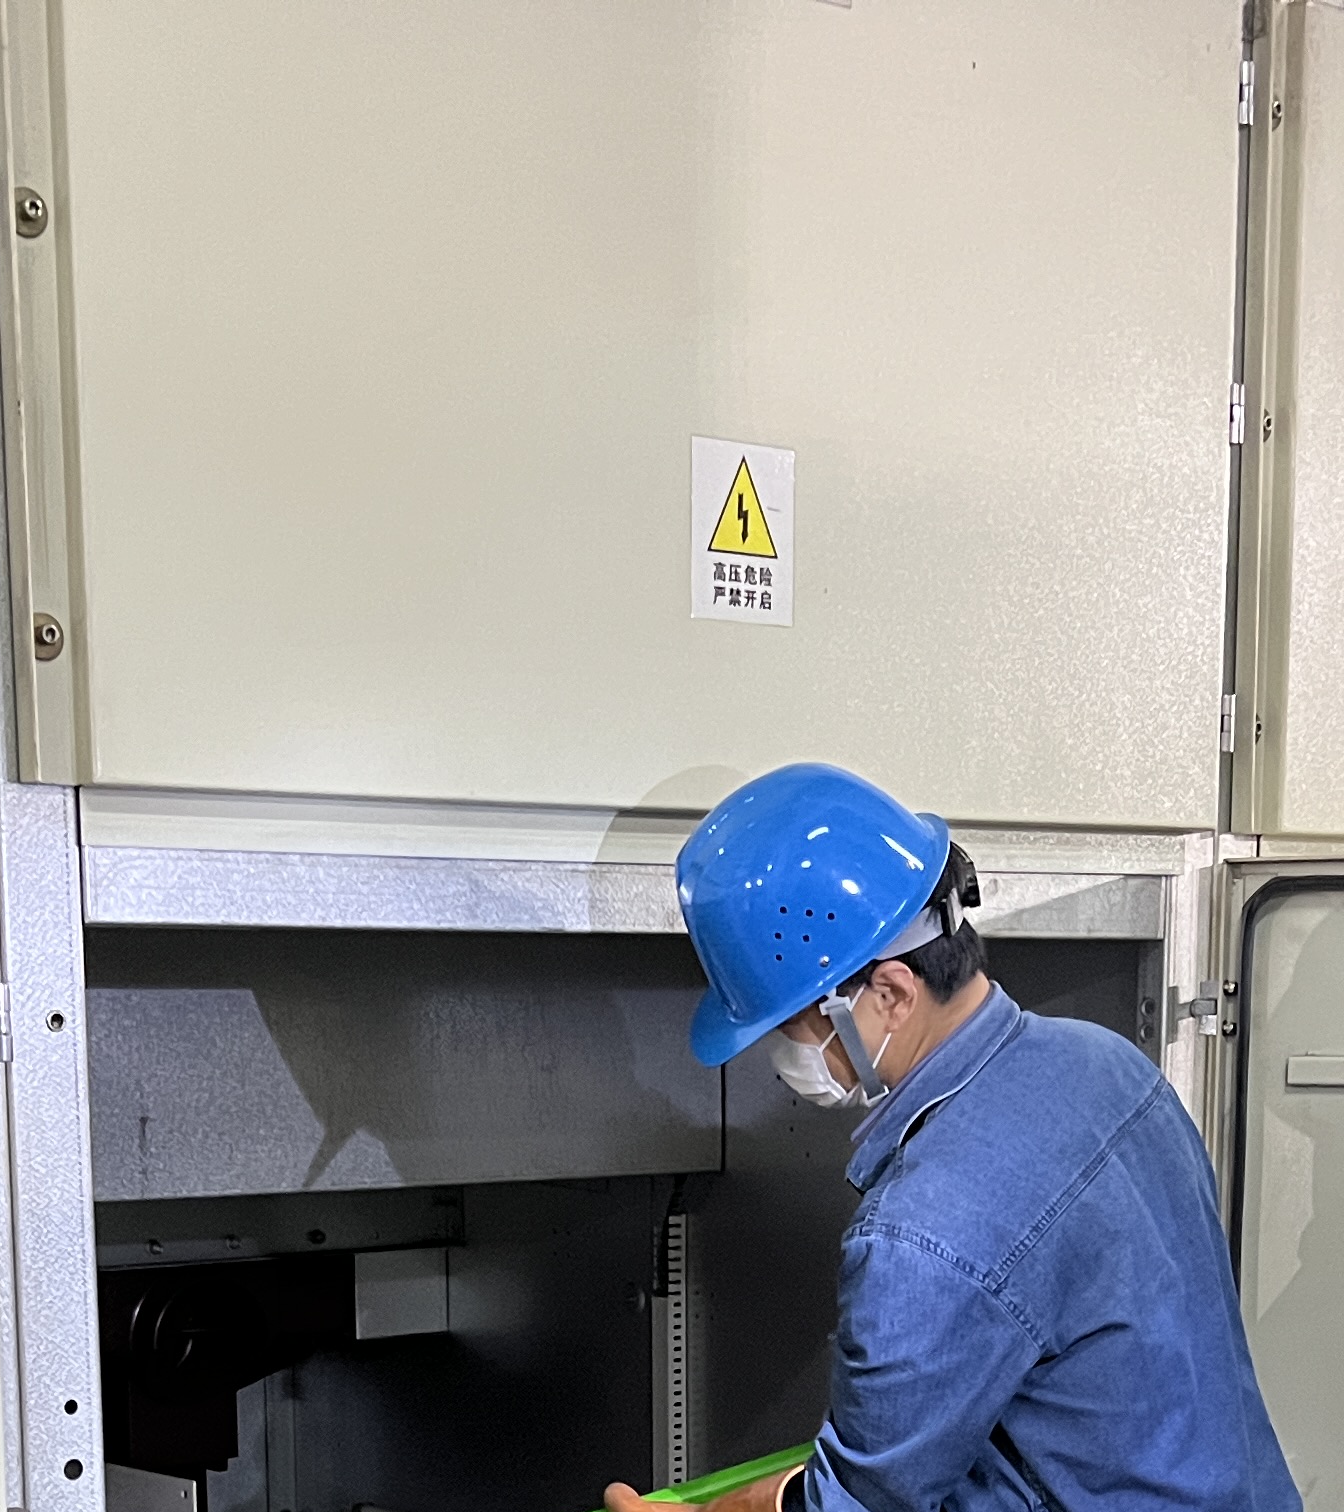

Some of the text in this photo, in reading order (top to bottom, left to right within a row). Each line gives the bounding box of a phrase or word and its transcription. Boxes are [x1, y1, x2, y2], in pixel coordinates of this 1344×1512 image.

[712, 561, 773, 588] 高压危险
[712, 586, 773, 611] 严禁开启
